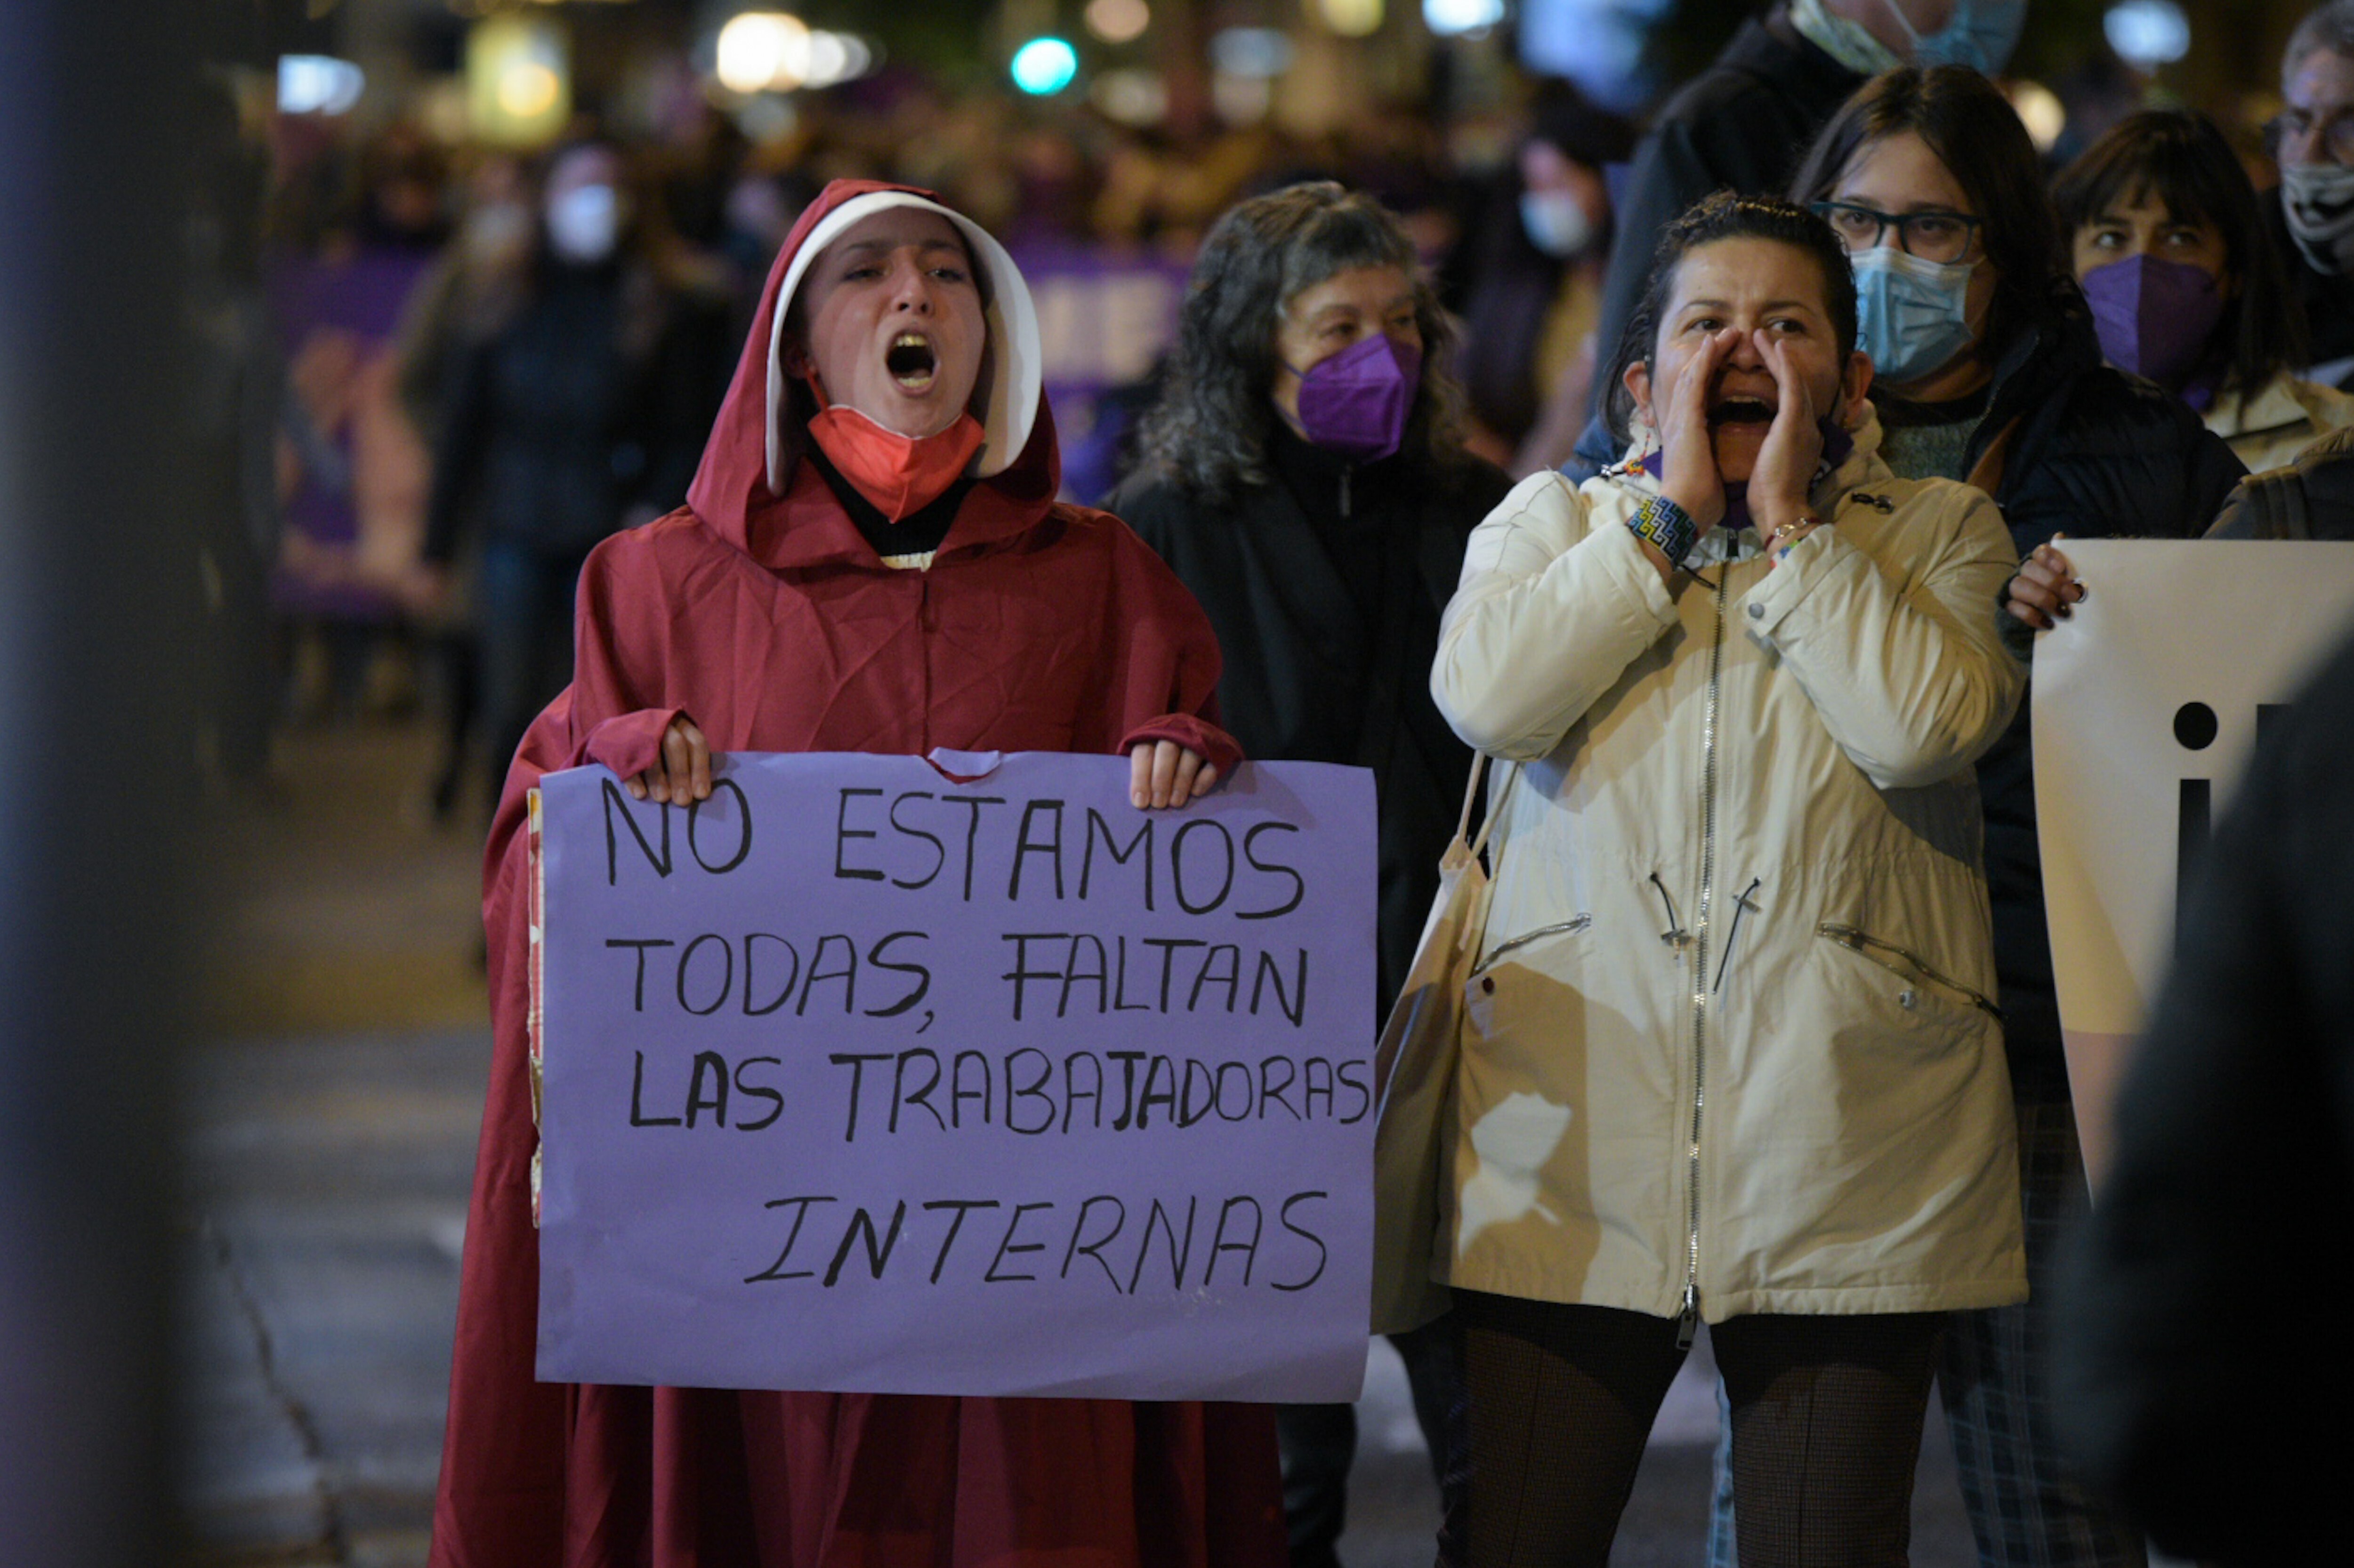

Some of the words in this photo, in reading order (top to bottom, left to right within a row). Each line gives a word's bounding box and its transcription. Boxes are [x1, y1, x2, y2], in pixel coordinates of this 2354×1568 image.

[602, 777, 752, 886] NO
[835, 788, 1305, 920] ESTAMOS
[605, 932, 935, 1034] TODAS,
[1001, 933, 1308, 1028] FALTAN
[630, 1050, 785, 1132] LAS
[829, 1047, 1370, 1142] TRABAJADORAS
[743, 1190, 1329, 1295] INTERNAS
